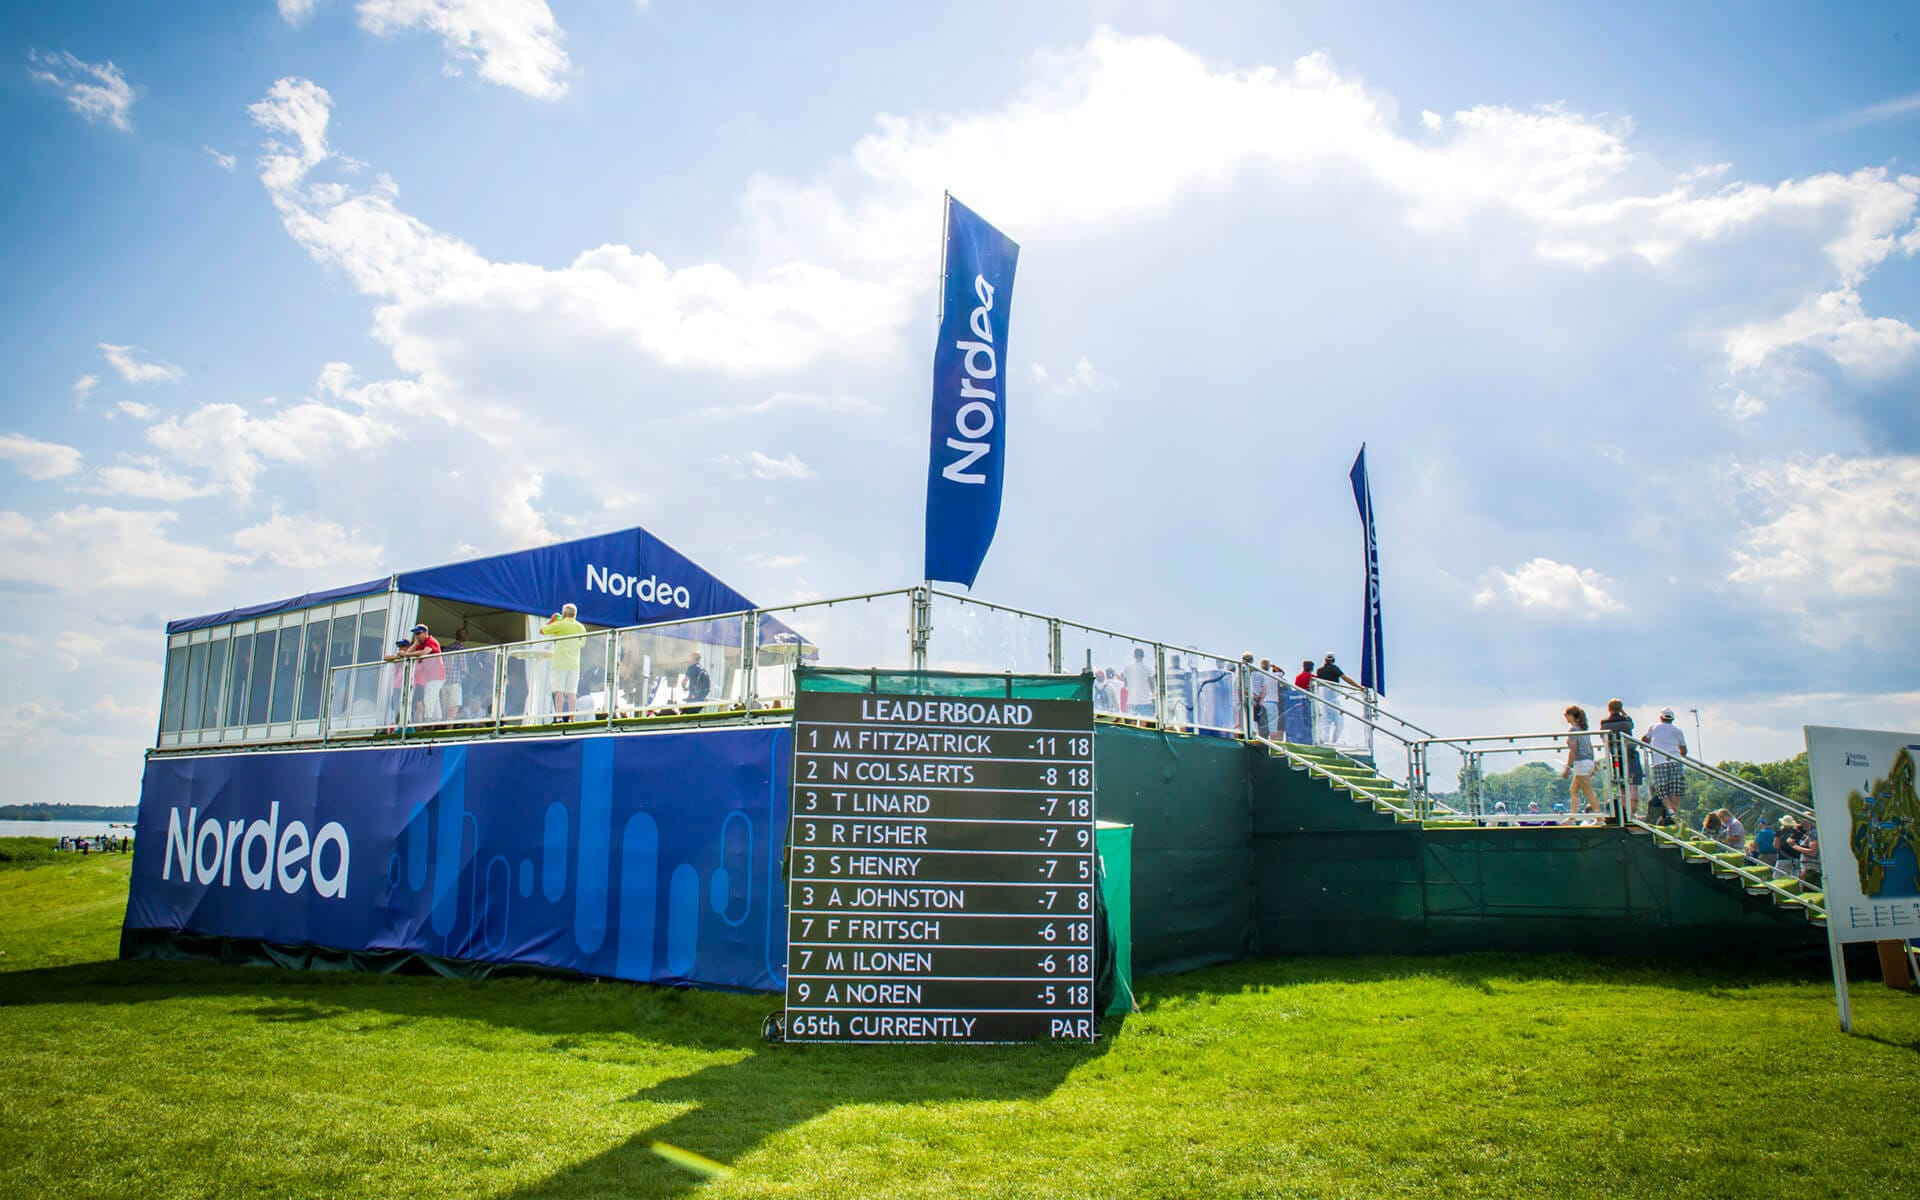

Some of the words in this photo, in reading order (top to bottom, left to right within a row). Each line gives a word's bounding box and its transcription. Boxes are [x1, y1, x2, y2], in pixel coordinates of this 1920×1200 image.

[942, 274, 997, 486] Nordea
[586, 563, 691, 610] Nordea
[859, 699, 1033, 727] LEADERBOARD
[809, 729, 818, 748] 1
[832, 730, 852, 750] M
[855, 731, 992, 754] FITZPATRICK
[1028, 737, 1056, 756] -11
[1068, 738, 1090, 756] 18
[807, 760, 818, 780] 2
[832, 761, 849, 780] N
[855, 762, 975, 784] COLSAERTS
[1039, 767, 1058, 786] -8
[1068, 768, 1089, 787] 18
[806, 791, 817, 811] 3
[831, 792, 848, 812] T
[853, 793, 931, 814] LINARD
[1039, 798, 1059, 817] -7
[1068, 799, 1090, 817] 18
[804, 823, 816, 842] 3
[831, 824, 846, 843] R
[852, 824, 928, 845] FISHER
[1038, 829, 1058, 848] -7
[1077, 829, 1089, 848] 9
[162, 801, 350, 899] Nordea
[803, 855, 815, 874] 3
[830, 855, 842, 875] S
[849, 856, 921, 876] HENRY
[1038, 860, 1058, 879] -7
[1079, 860, 1089, 879] 5
[802, 886, 814, 906] 3
[827, 887, 843, 906] A
[849, 888, 964, 909] JOHNSTON
[1038, 891, 1058, 910] -7
[1078, 891, 1089, 910] 8
[801, 919, 814, 938] 7
[827, 919, 841, 938] F
[848, 919, 940, 940] FRITSCH
[1038, 923, 1057, 941] -6
[1067, 923, 1089, 942] 18
[800, 951, 813, 970] 7
[825, 951, 845, 971] M
[853, 951, 932, 972] ILONEN
[1037, 954, 1056, 973] -6
[1067, 954, 1089, 973] 18
[797, 983, 811, 1002] 9
[824, 983, 839, 1003] A
[846, 984, 921, 1004] NOREN
[1037, 986, 1056, 1005] -5
[1067, 986, 1089, 1005] 18
[792, 1015, 840, 1036] 65th
[849, 1016, 977, 1037] CURRENTLY
[1051, 1019, 1090, 1038] PAR
